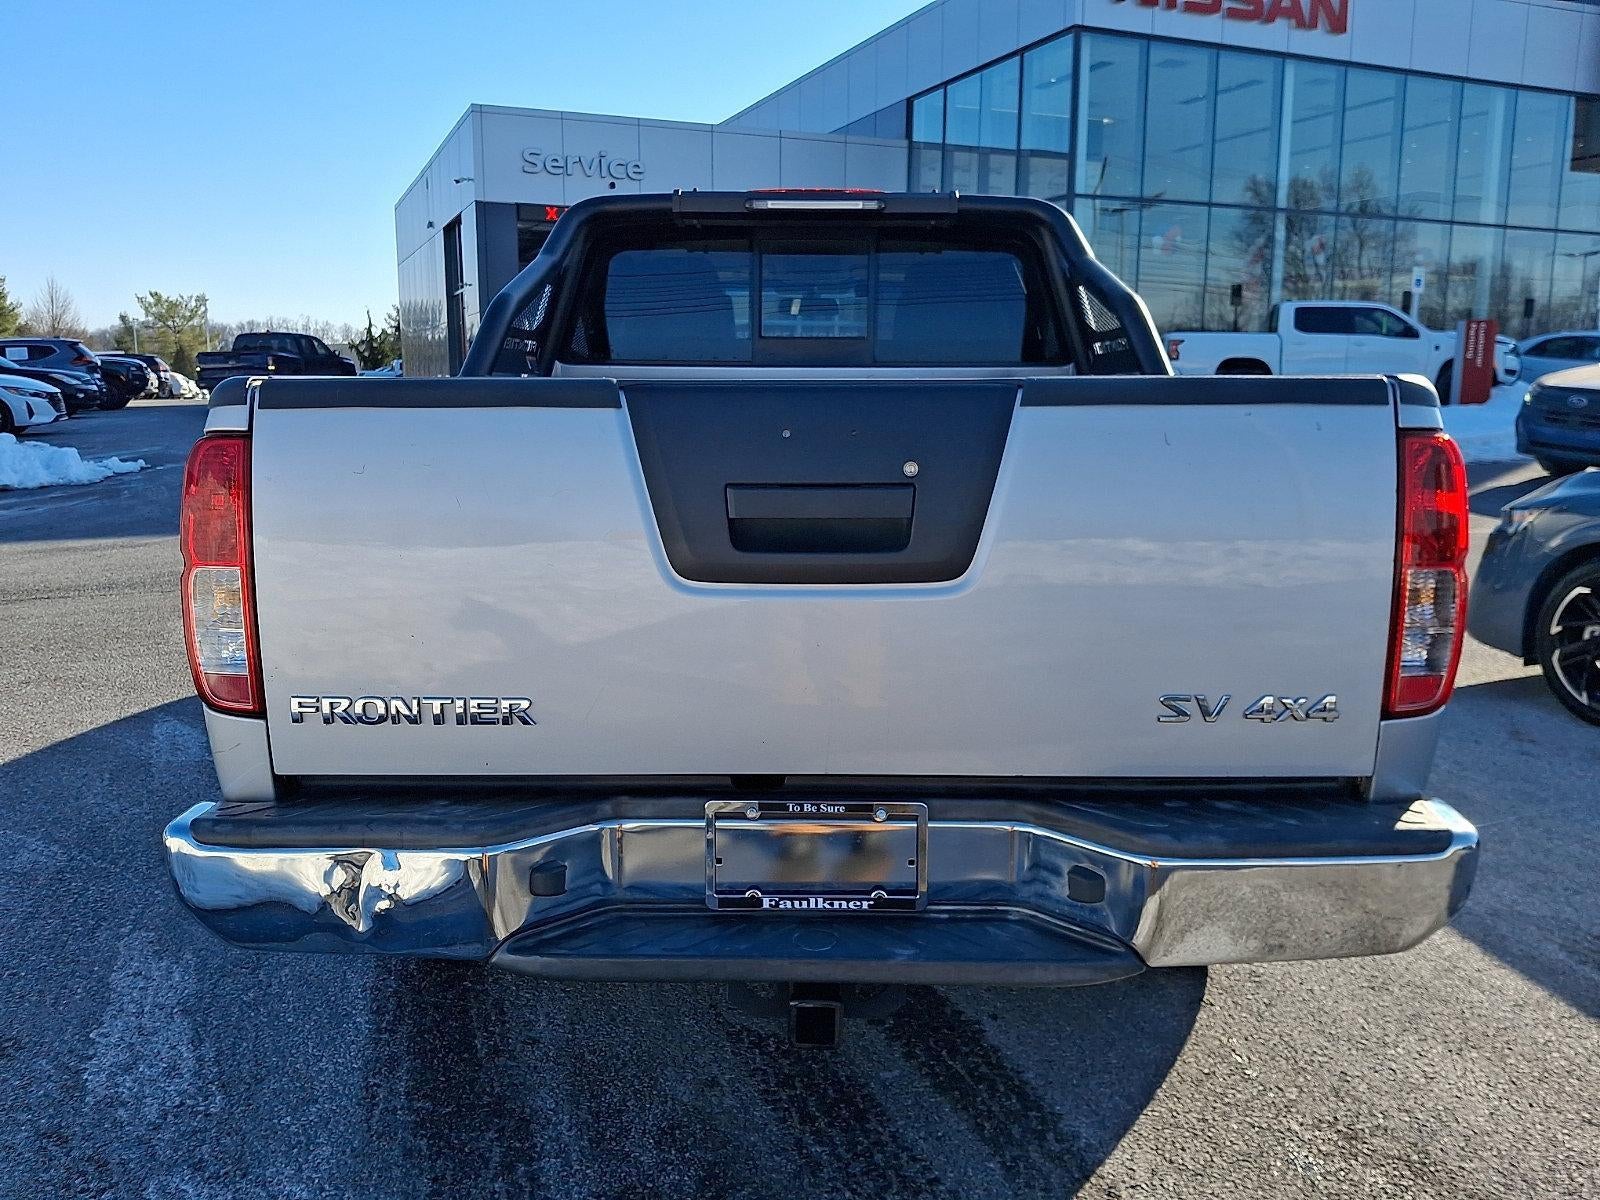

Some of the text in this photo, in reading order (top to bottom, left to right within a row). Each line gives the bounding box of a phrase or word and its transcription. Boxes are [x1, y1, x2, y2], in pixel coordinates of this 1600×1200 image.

[521, 148, 645, 181] Service
[289, 695, 537, 726] FRONTIER
[1158, 694, 1231, 723] SV
[787, 803, 846, 813] To Be Sure
[761, 897, 875, 910] Faulkner
